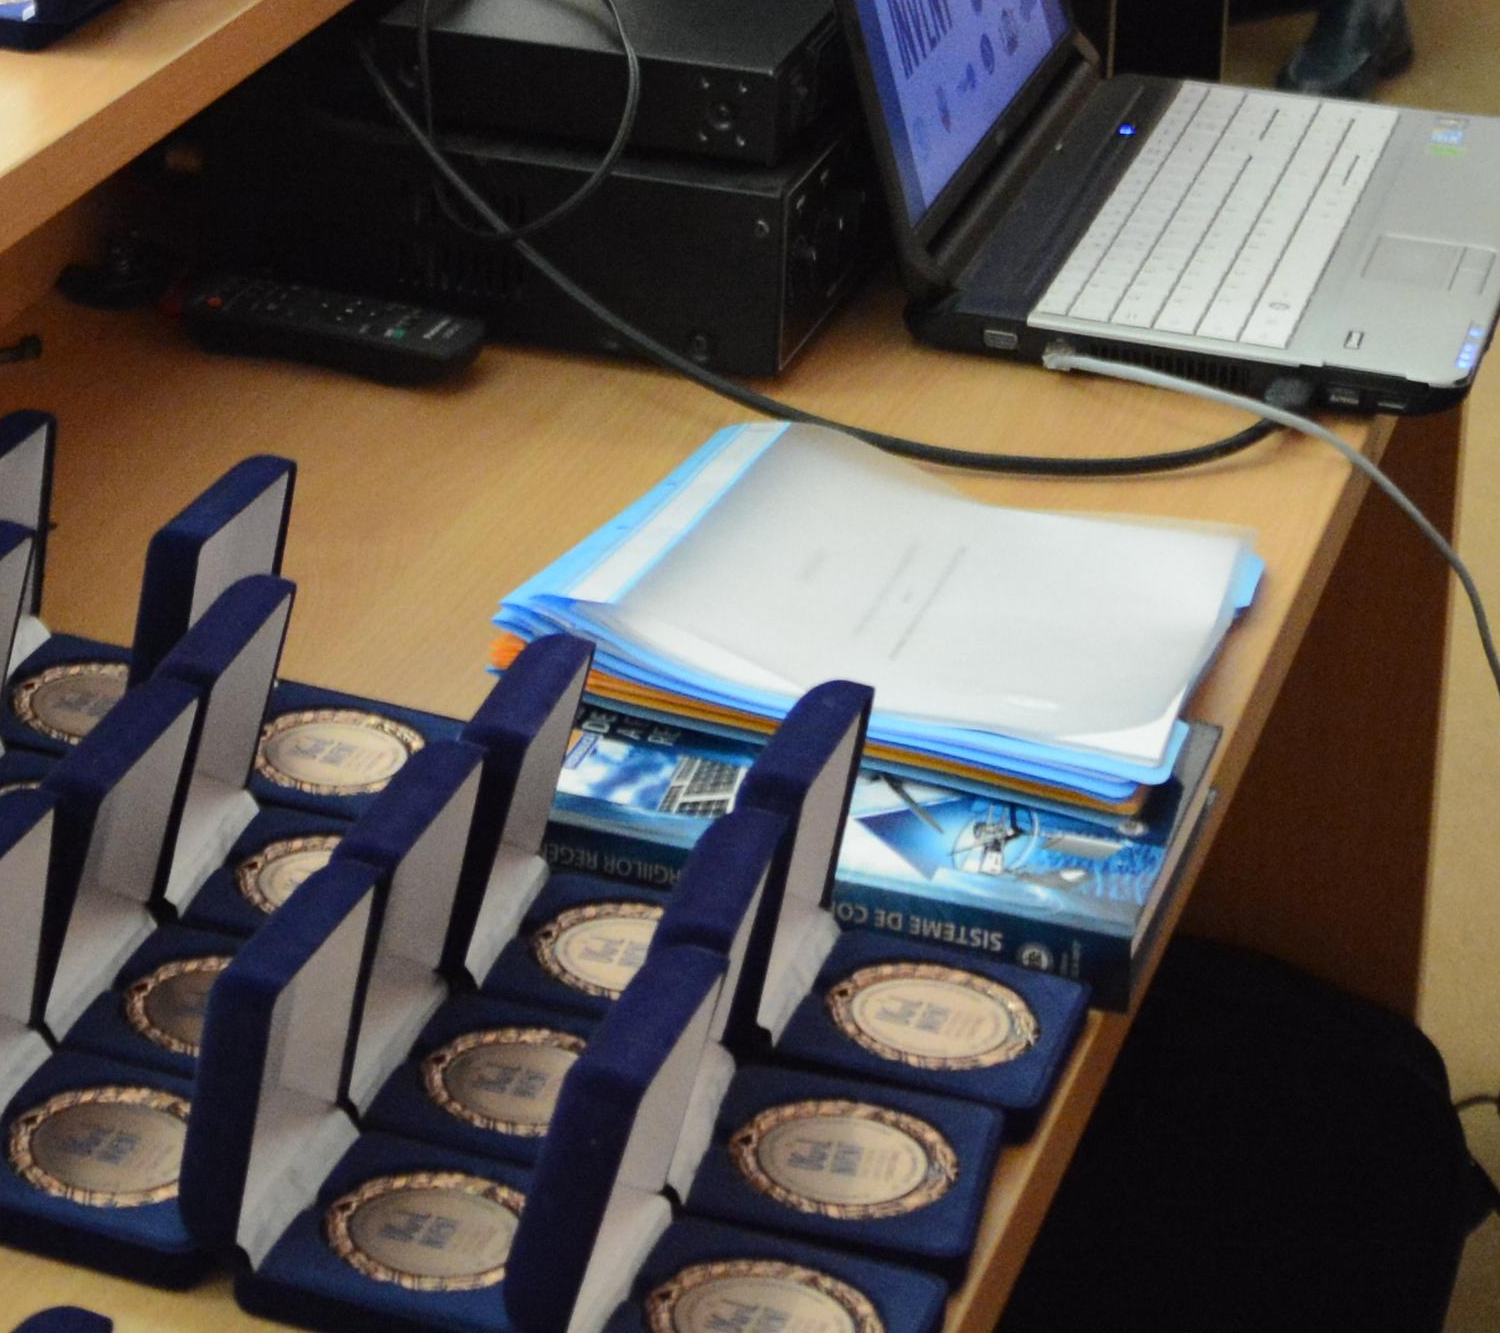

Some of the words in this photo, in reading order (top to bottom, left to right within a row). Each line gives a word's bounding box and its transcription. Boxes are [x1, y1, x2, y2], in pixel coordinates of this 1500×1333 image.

[542, 842, 599, 871] REGE
[833, 900, 869, 924] CO
[874, 909, 904, 931] DE
[910, 914, 1004, 952] SISTEME
